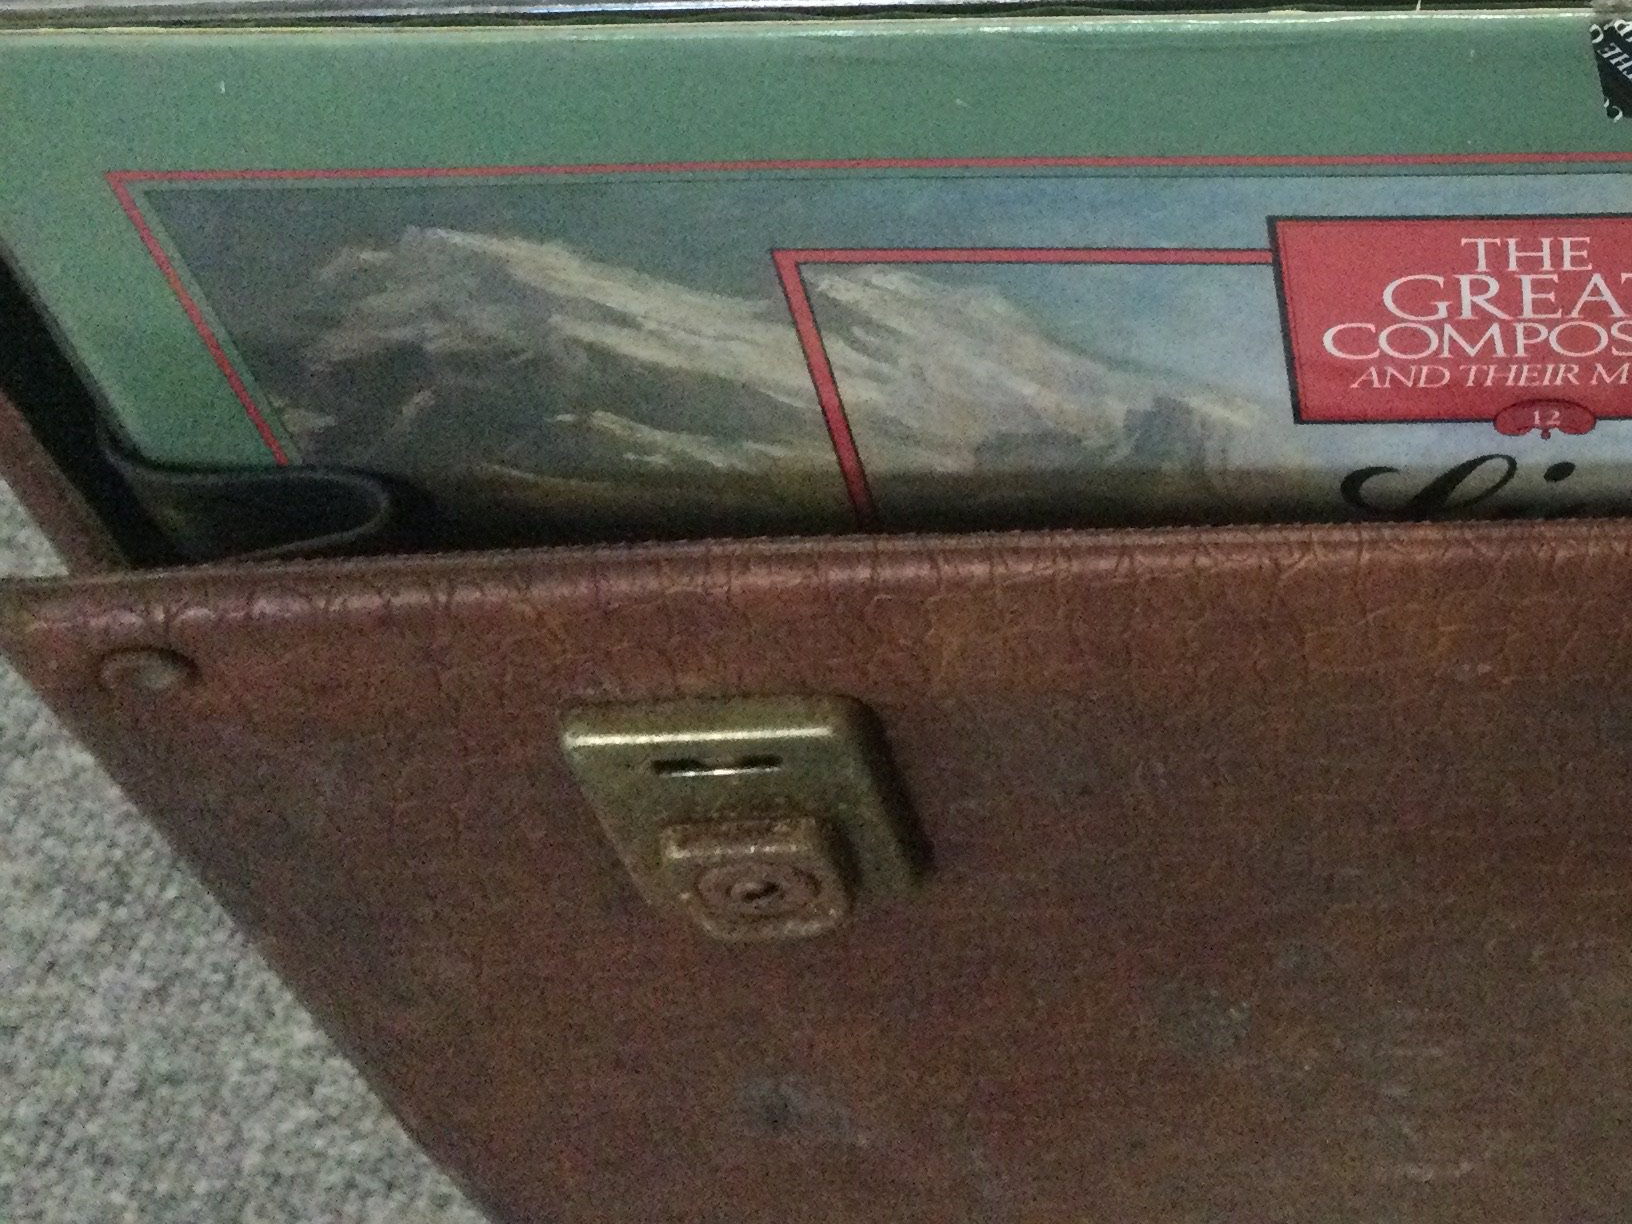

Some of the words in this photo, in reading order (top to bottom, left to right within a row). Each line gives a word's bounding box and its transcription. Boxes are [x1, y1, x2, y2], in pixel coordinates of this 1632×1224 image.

[1461, 236, 1592, 272] THE
[1350, 364, 1454, 389] AND
[1461, 362, 1580, 387] THEIR
[1532, 409, 1561, 426] 12
